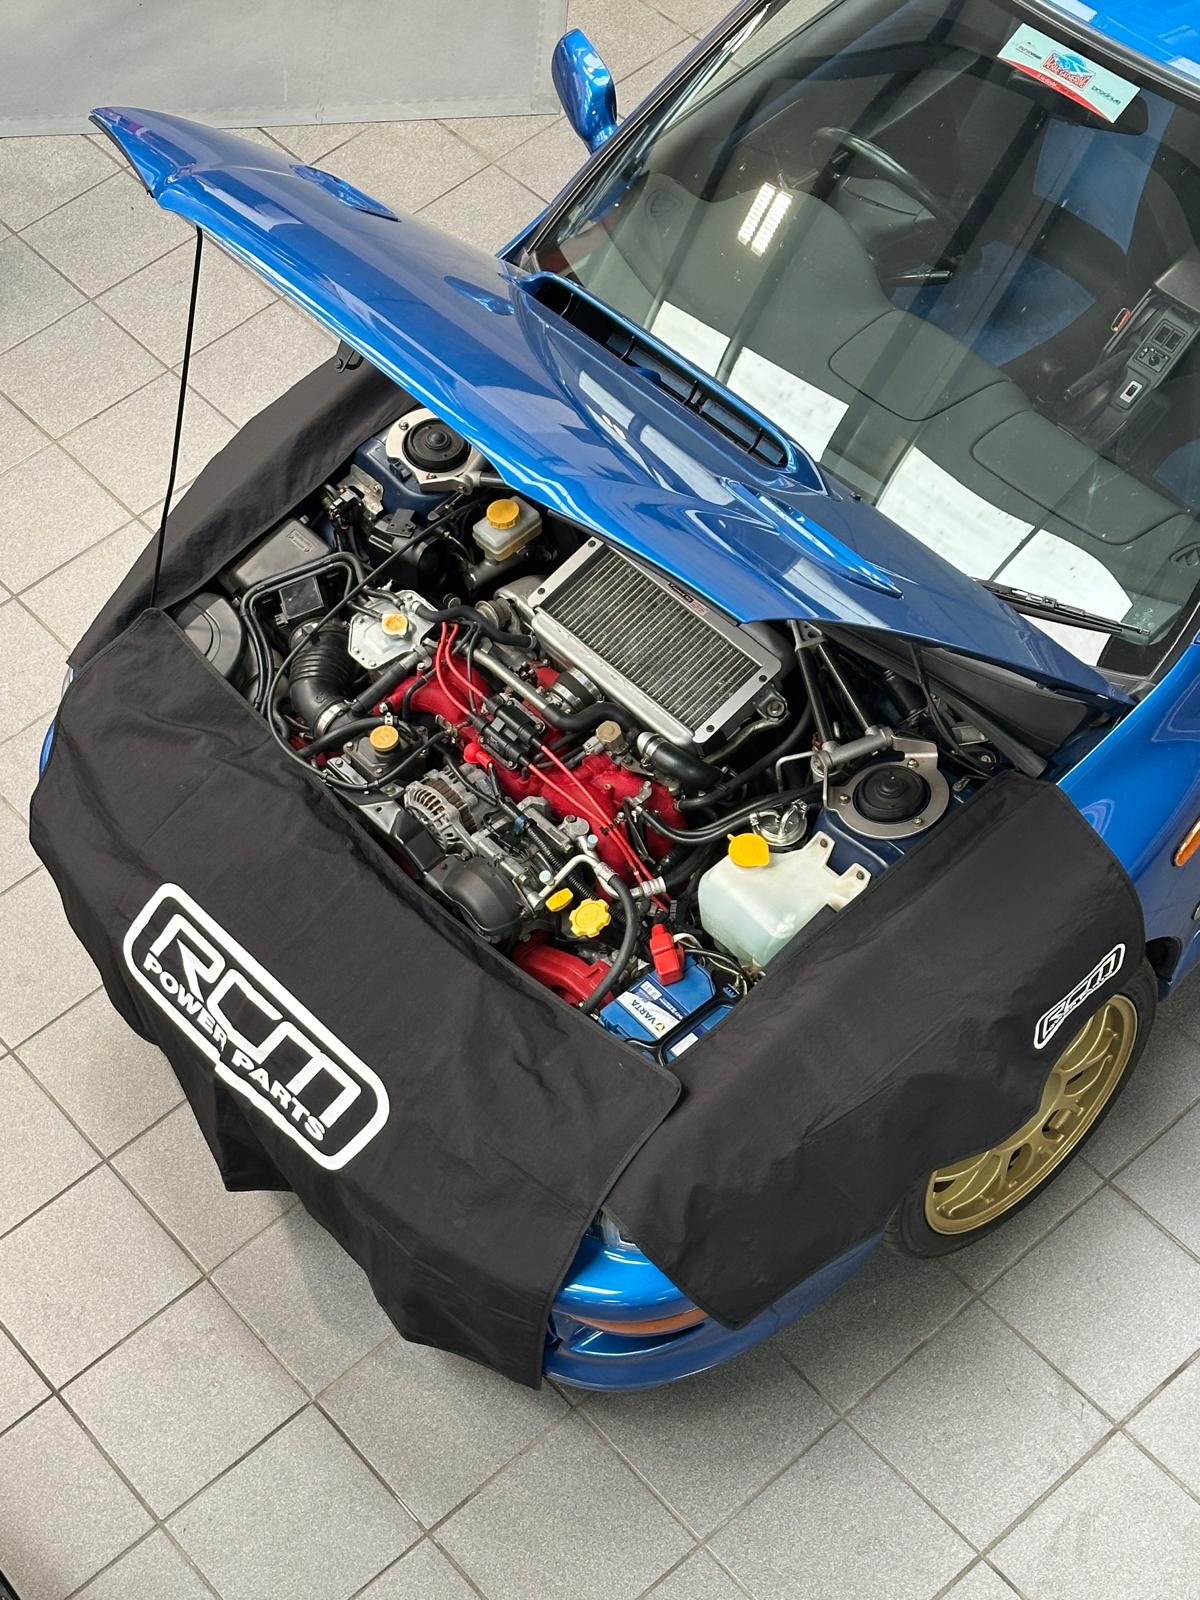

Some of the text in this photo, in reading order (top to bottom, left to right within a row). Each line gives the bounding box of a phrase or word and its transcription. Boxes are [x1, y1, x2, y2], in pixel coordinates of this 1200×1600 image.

[143, 952, 326, 1141] POWER PARTS
[149, 913, 361, 1128] RCM
[631, 999, 656, 1025] VARTA
